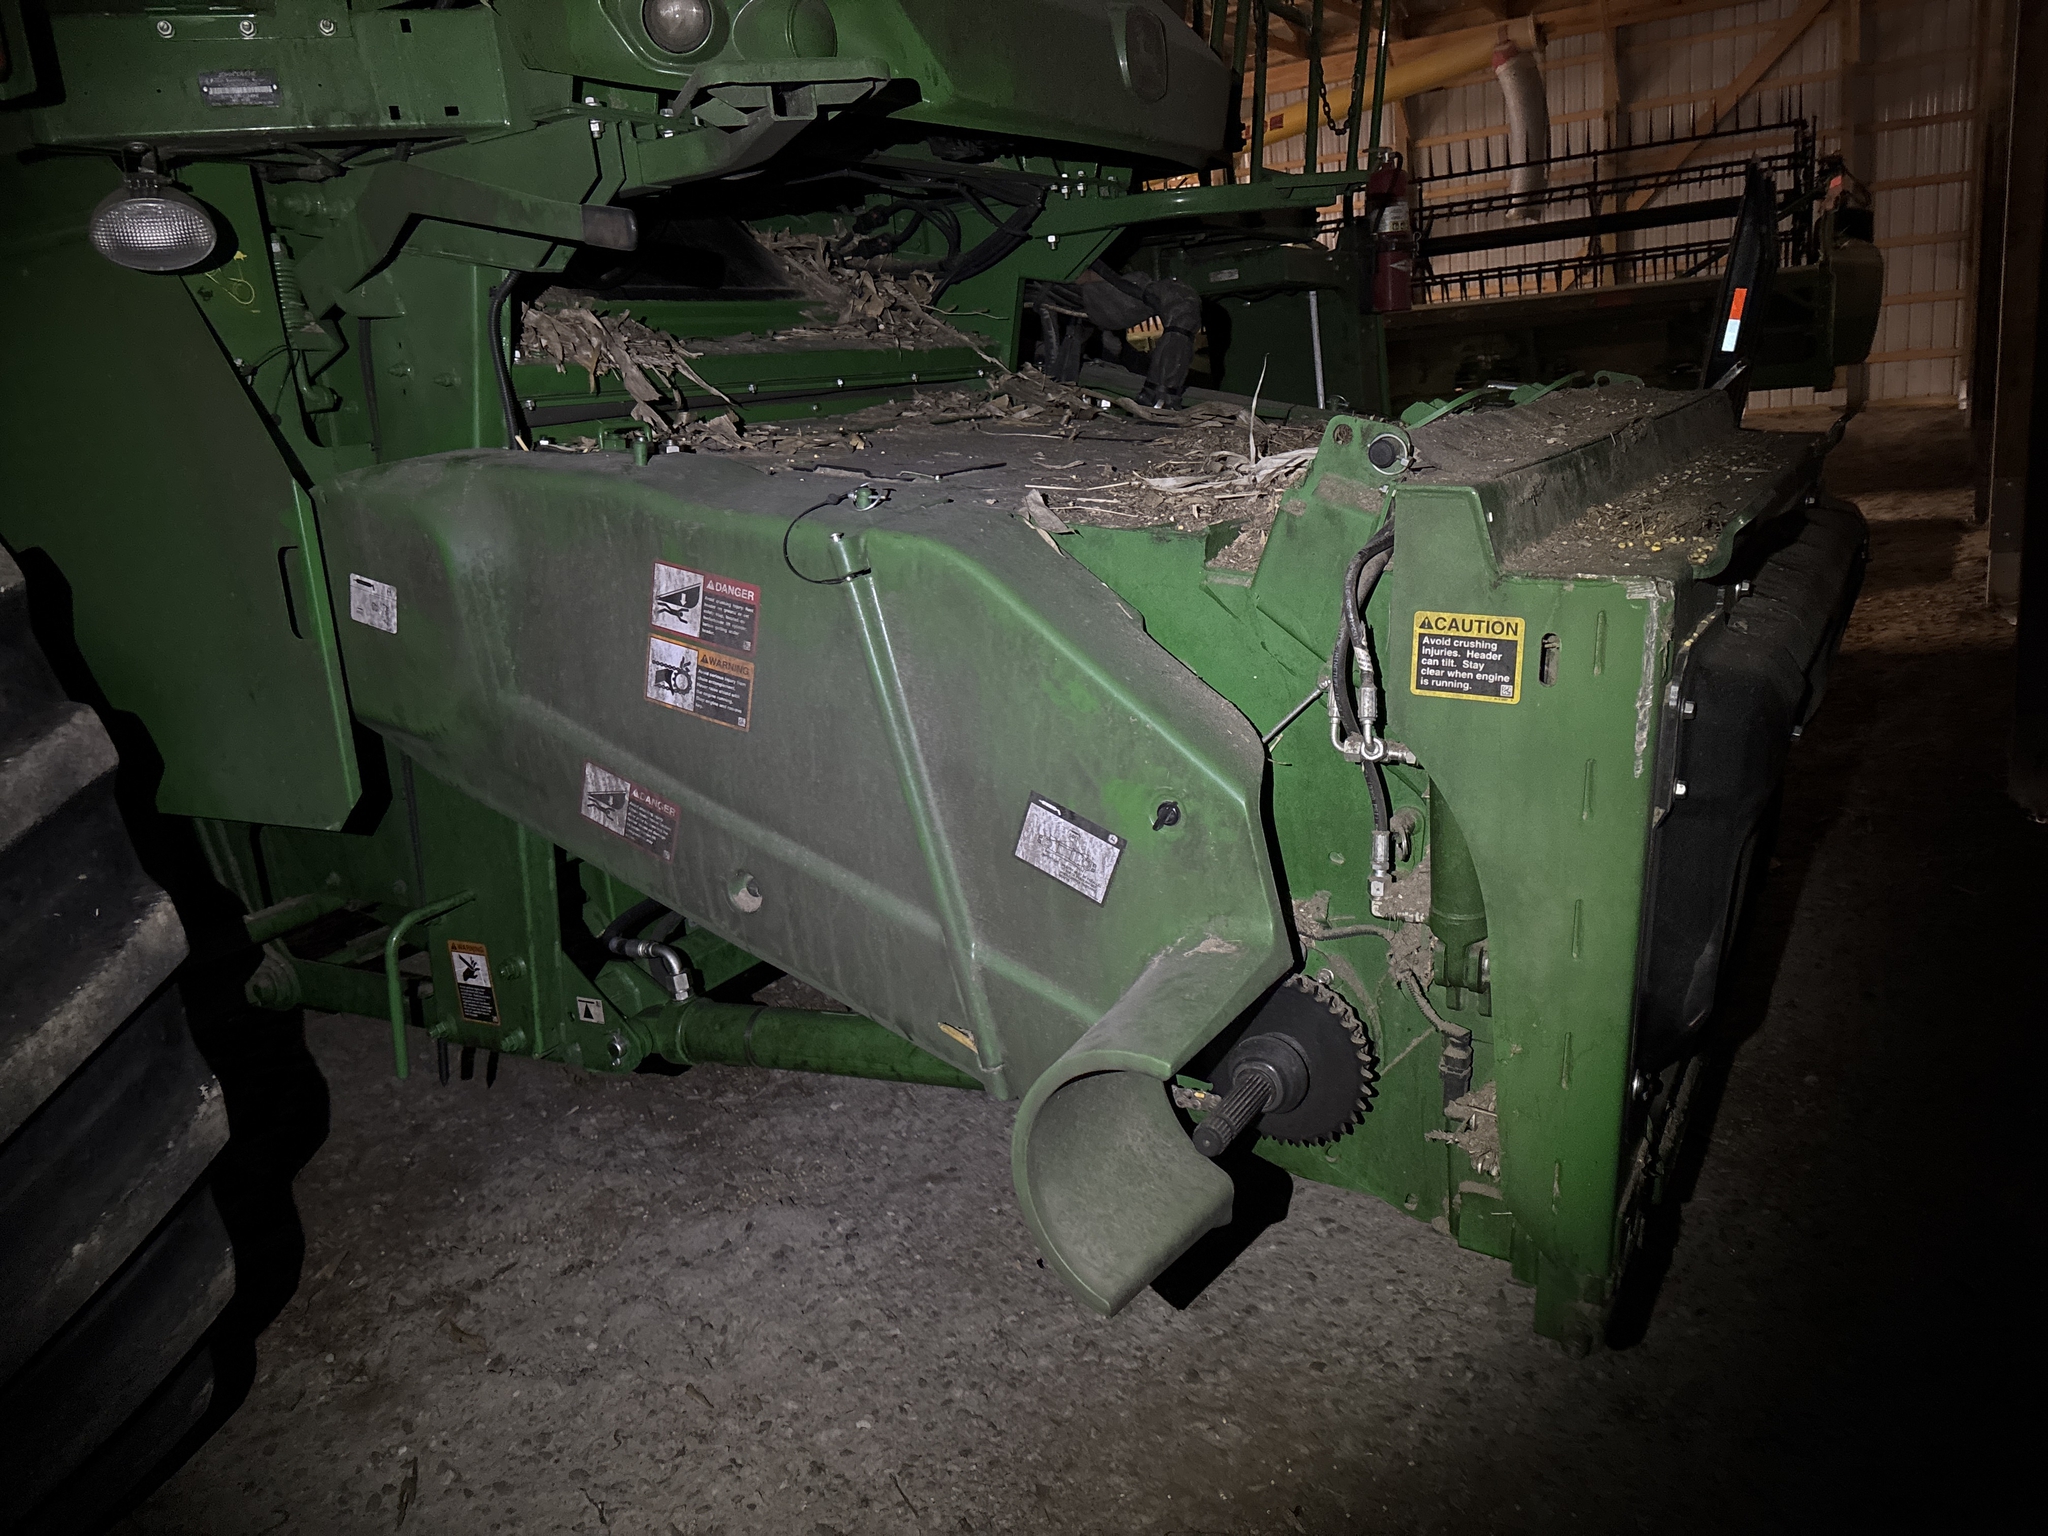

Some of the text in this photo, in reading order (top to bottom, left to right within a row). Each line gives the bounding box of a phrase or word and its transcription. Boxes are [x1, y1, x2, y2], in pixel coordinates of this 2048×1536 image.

[715, 581, 755, 601] DANGER
[1434, 616, 1519, 637] CAUTION
[1422, 636, 1498, 652] Avoid crushing
[1422, 646, 1502, 661] injuries. Header
[709, 657, 750, 675] WARNING
[1421, 658, 1485, 672] can tilt. Stay
[1420, 667, 1510, 683] clear when engine
[1420, 677, 1472, 691] is running.
[639, 792, 676, 817] DANGER
